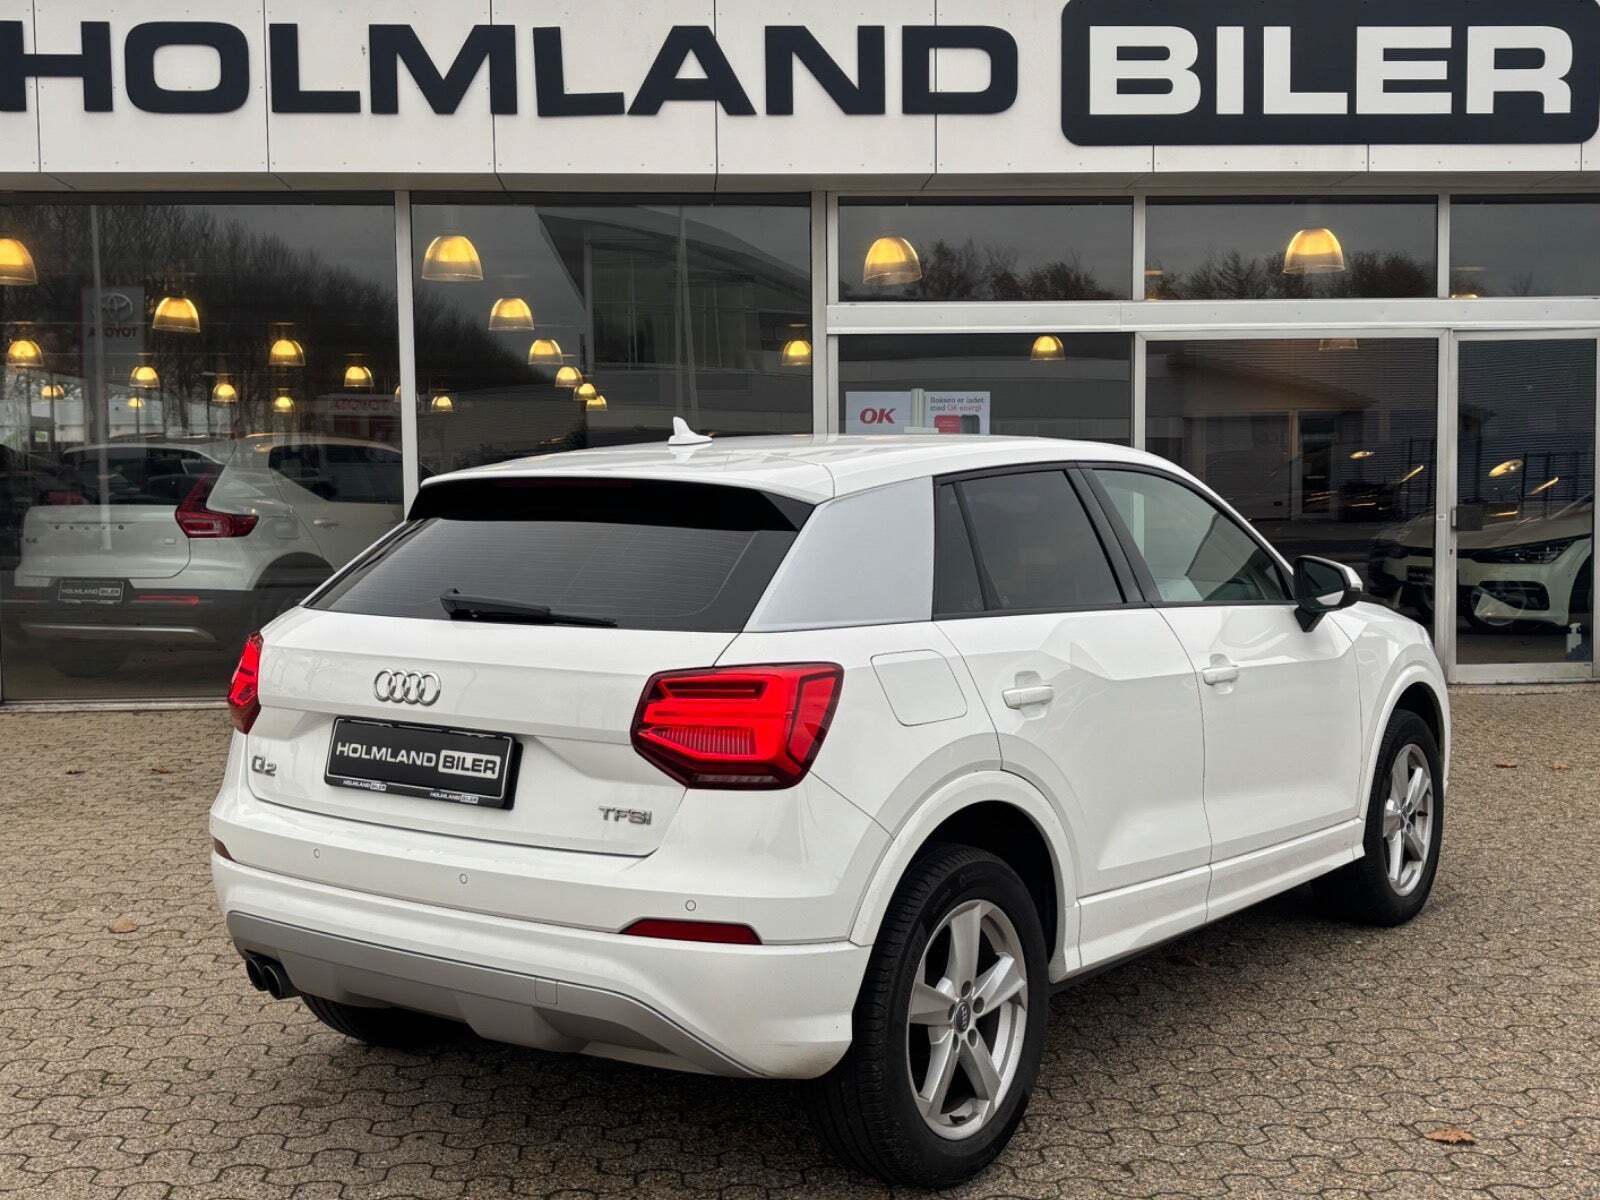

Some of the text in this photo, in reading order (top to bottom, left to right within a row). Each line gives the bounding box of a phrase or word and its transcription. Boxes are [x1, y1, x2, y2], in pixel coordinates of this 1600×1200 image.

[0, 20, 1573, 116] HOLMLAND BILER
[859, 407, 896, 424] OK
[252, 755, 277, 777] Q2
[336, 742, 498, 775] HOLMLAND BILER
